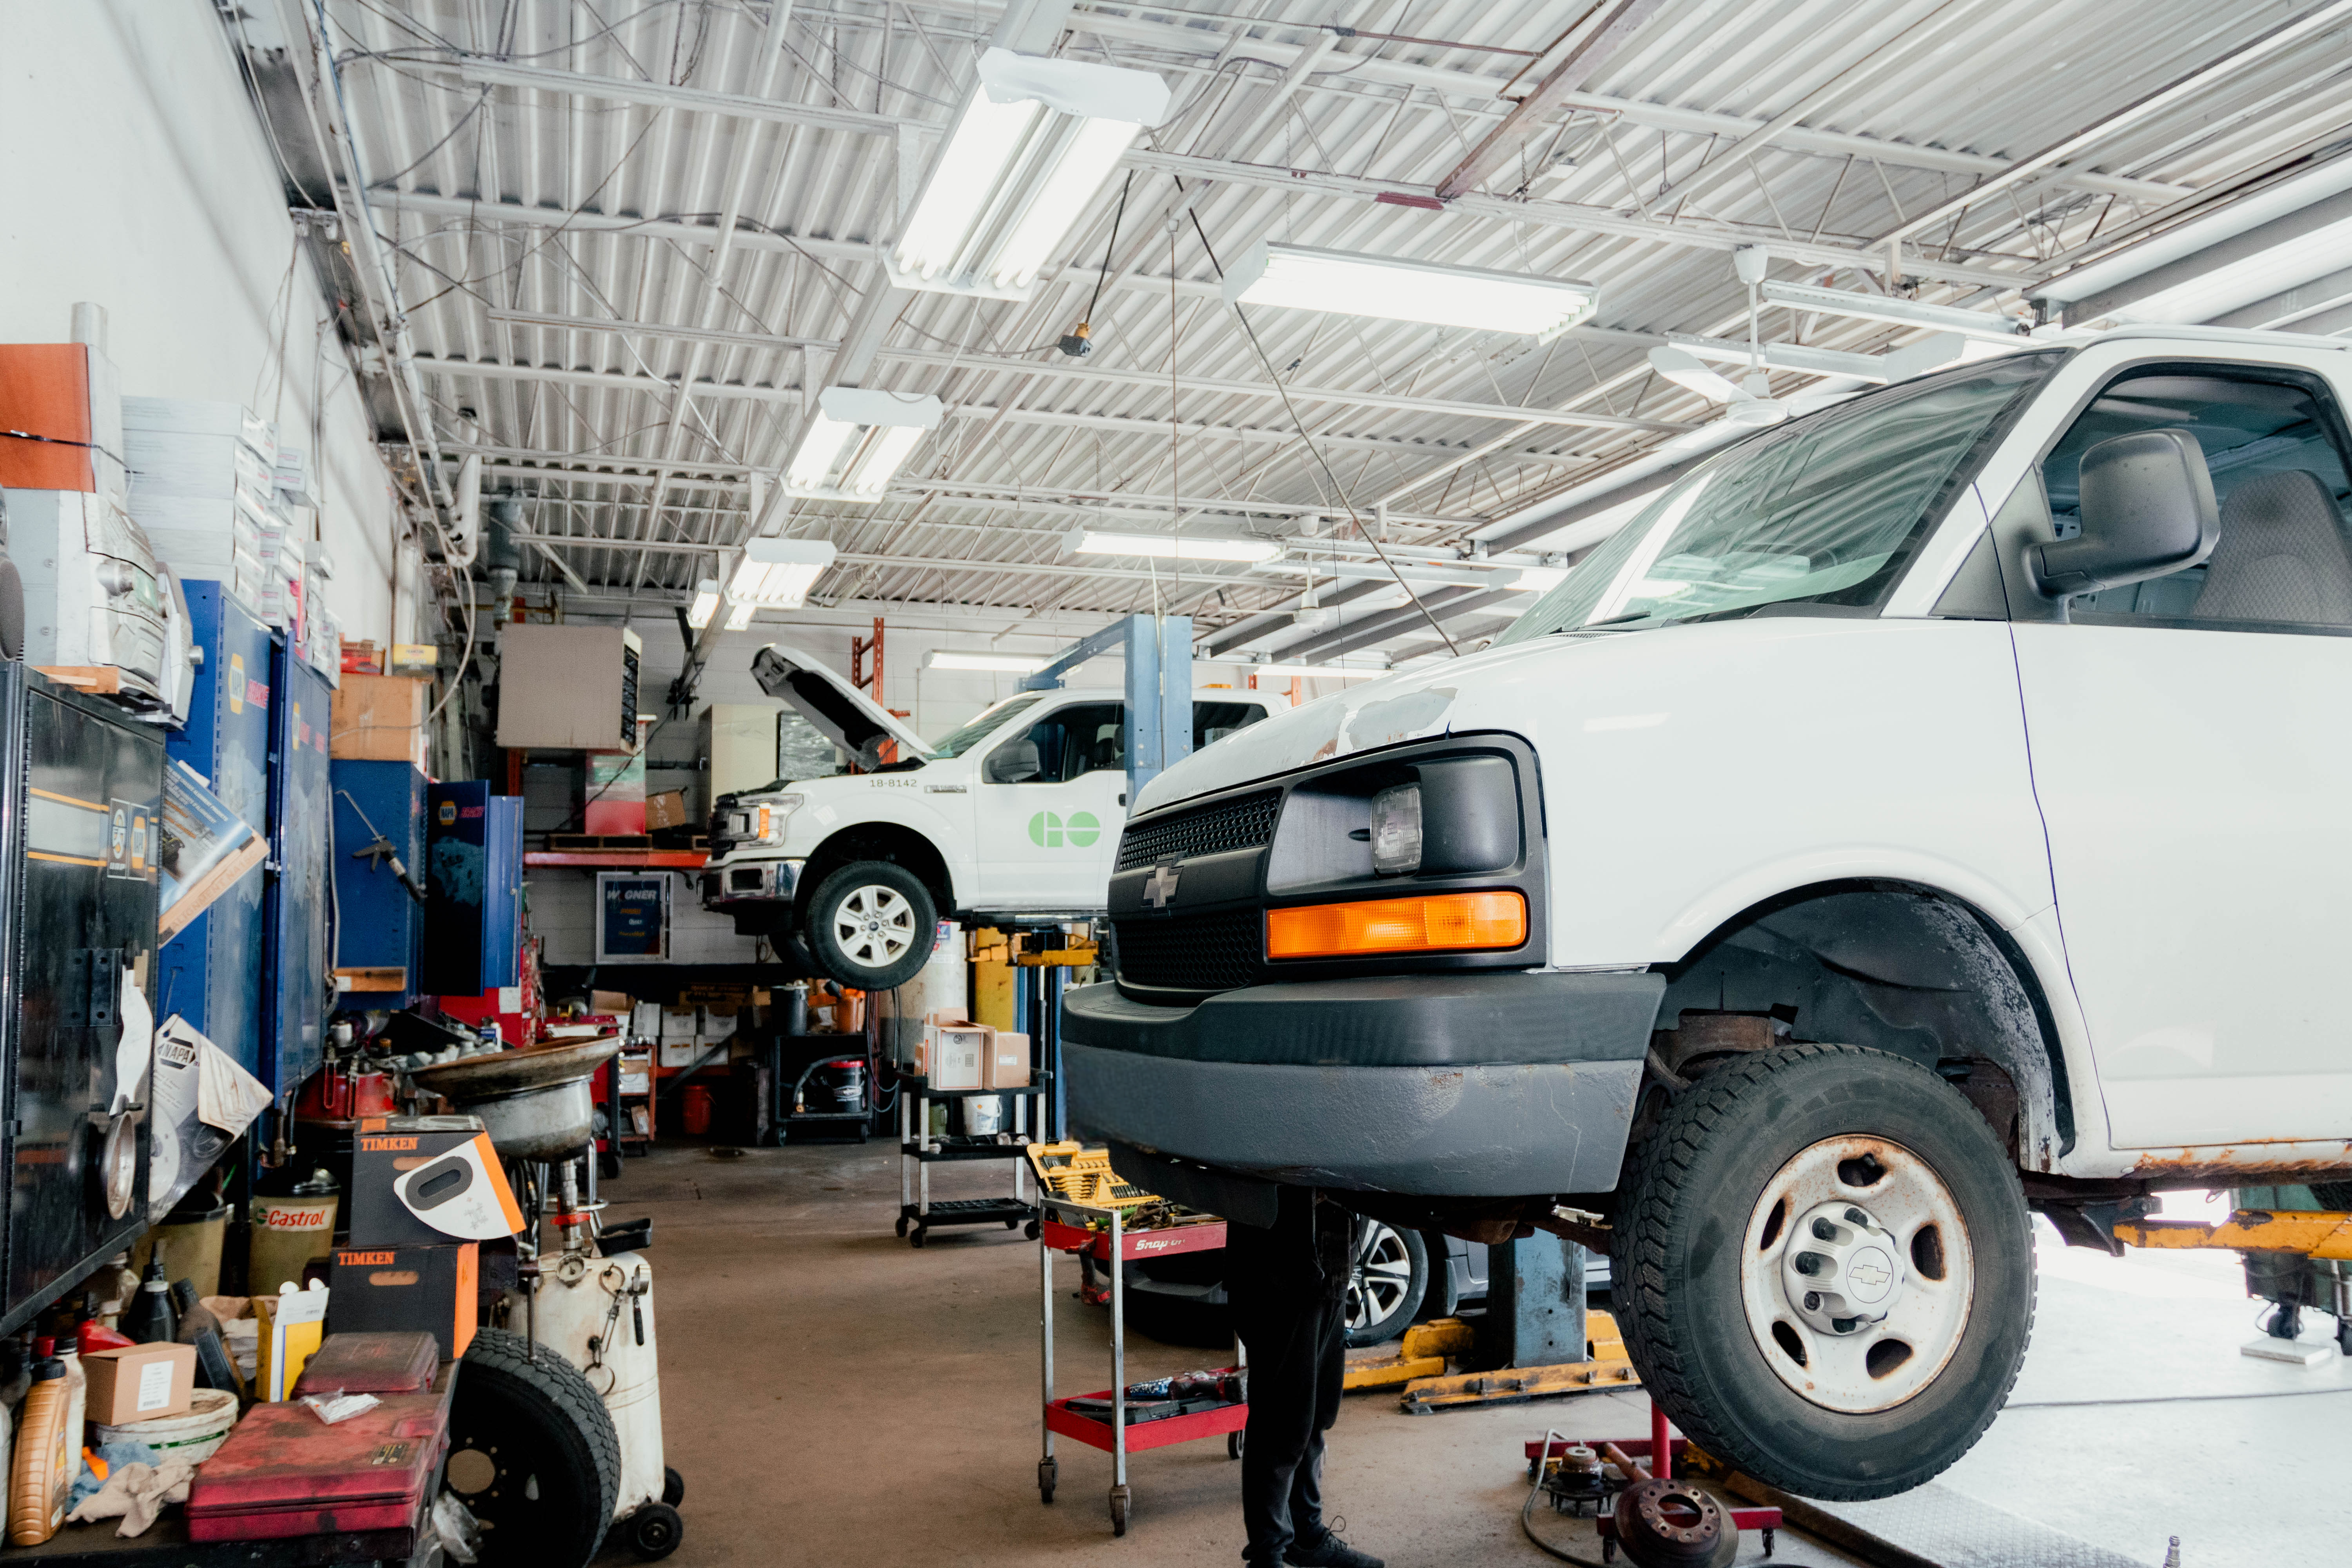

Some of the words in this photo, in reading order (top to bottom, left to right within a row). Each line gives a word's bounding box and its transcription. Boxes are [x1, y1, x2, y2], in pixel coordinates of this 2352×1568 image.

[869, 779, 917, 788] 18-8142
[1028, 811, 1101, 847] GO
[161, 1043, 191, 1063] NAPA
[361, 1137, 419, 1152] TIMKEN
[269, 1209, 326, 1226] Castrol
[338, 1252, 396, 1265] TIMKEN
